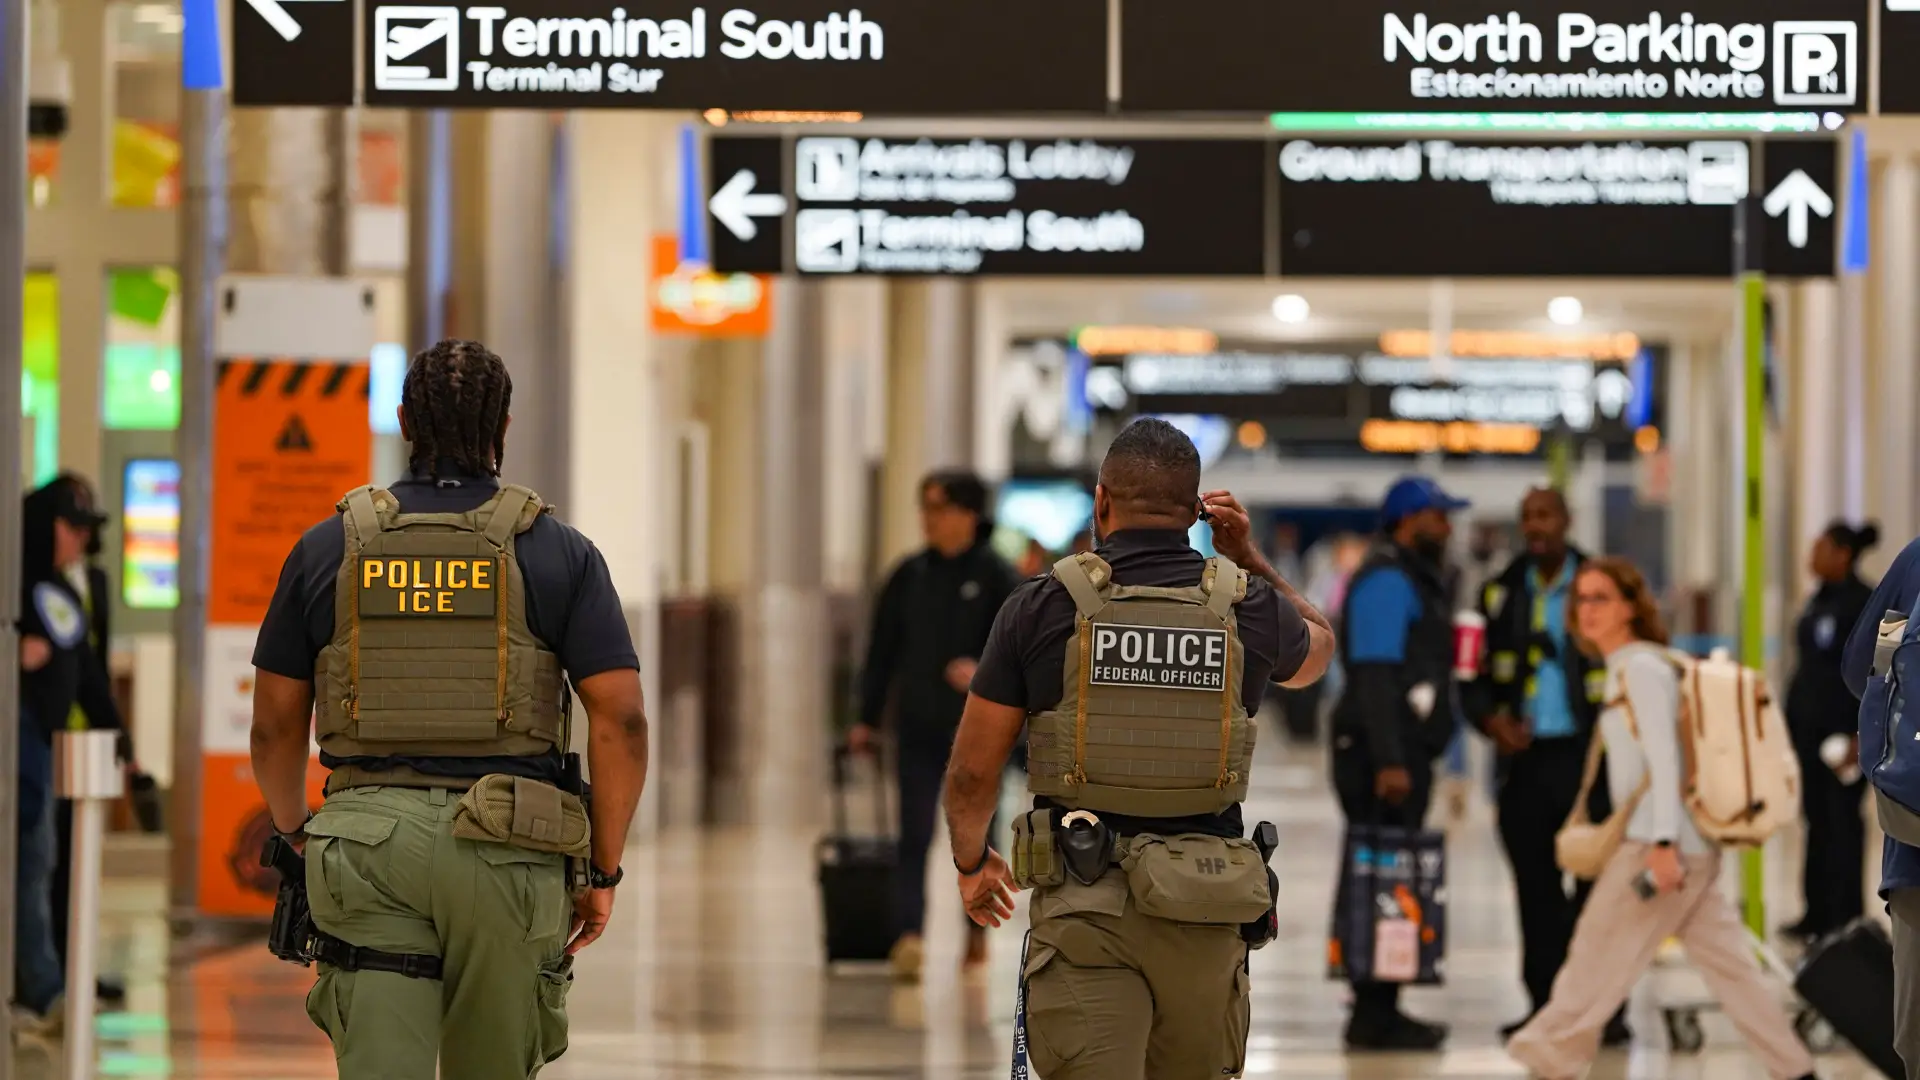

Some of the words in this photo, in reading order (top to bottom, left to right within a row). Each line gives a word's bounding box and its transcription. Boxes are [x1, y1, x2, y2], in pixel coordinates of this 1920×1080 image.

[466, 7, 705, 57] Terminal
[720, 9, 883, 60] South
[1384, 12, 1542, 62] North
[1558, 12, 1765, 73] Parking
[466, 62, 601, 91] Terminal
[607, 63, 663, 92] Sur
[1411, 68, 1668, 98] Estacionamiento
[1674, 69, 1765, 98] Norte
[860, 138, 1006, 179] Arrivals
[1008, 139, 1134, 185] Lobby
[1279, 140, 1422, 181] Ground
[1424, 140, 1688, 182] Transportation
[860, 209, 1024, 251] Terminal
[1026, 209, 1144, 251] South
[363, 560, 491, 589] POLICE
[399, 591, 454, 612] ICE
[1096, 630, 1223, 667] POLICE
[1094, 666, 1156, 682] FEDERAL
[1160, 669, 1220, 686] OFFICER
[1195, 857, 1226, 875] HP
[1017, 1026, 1025, 1054] DHS
